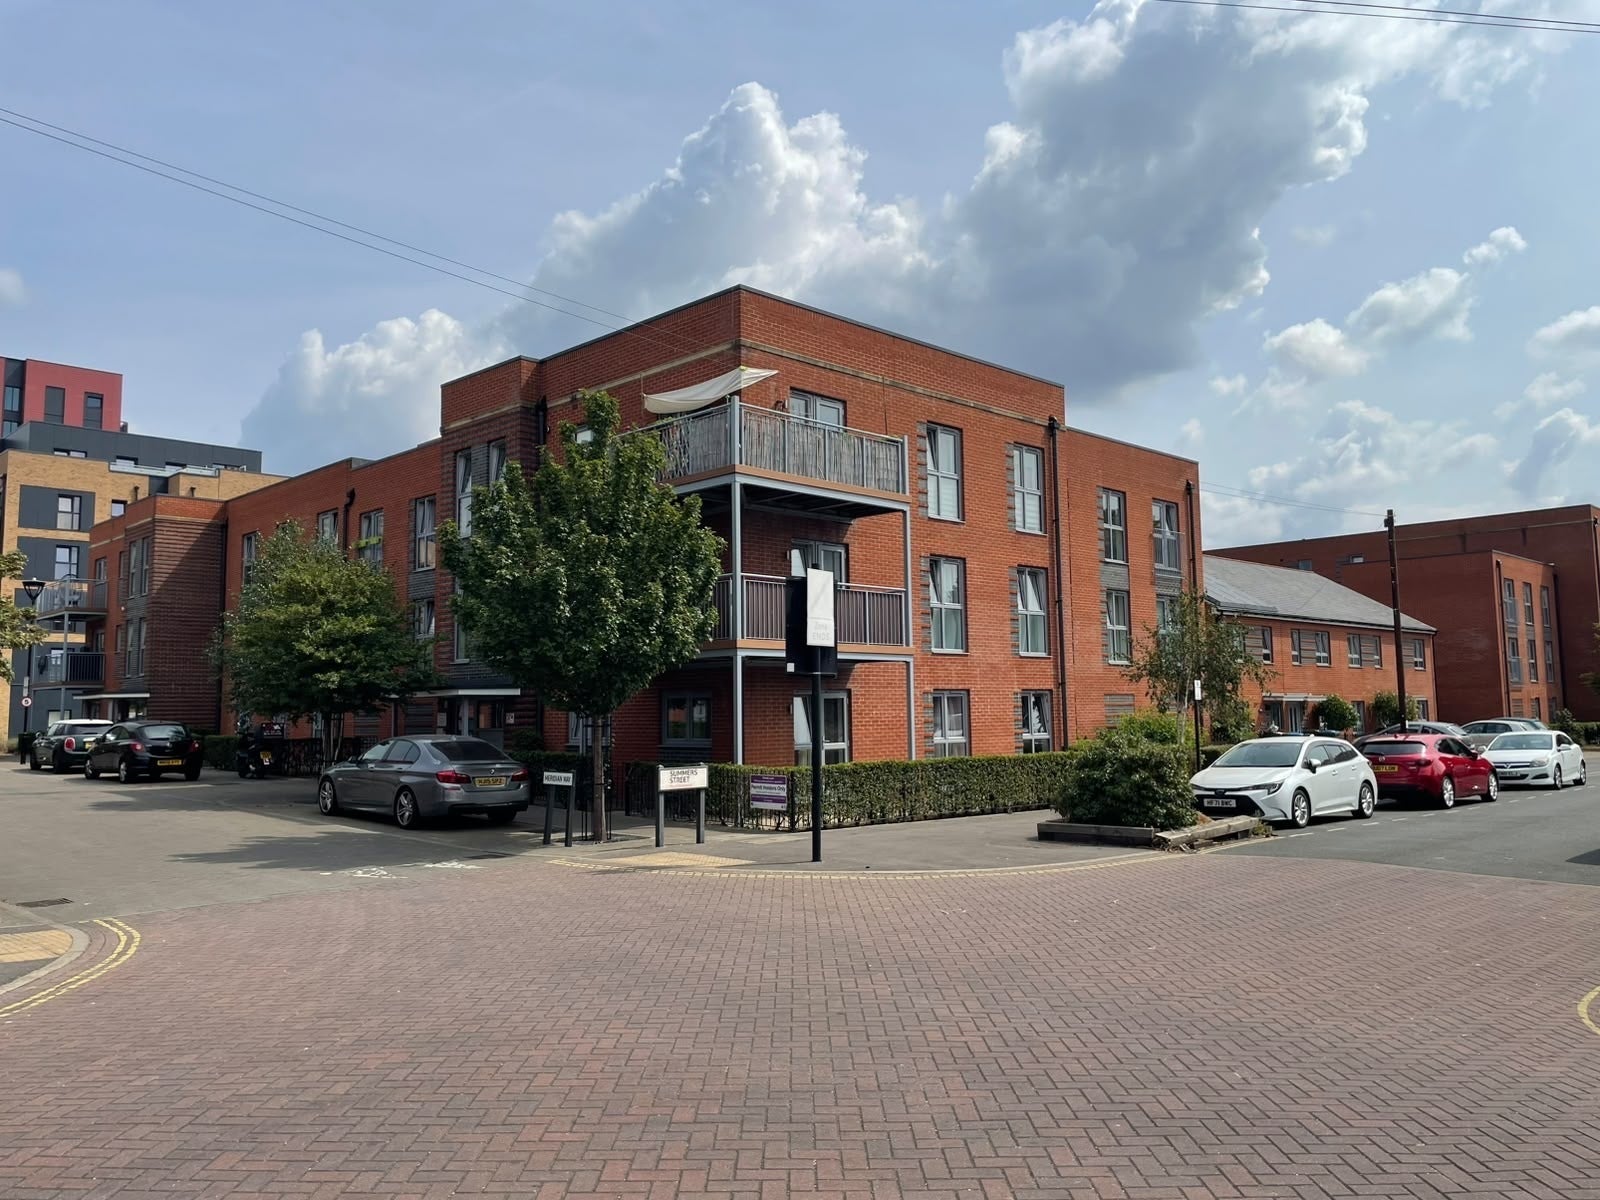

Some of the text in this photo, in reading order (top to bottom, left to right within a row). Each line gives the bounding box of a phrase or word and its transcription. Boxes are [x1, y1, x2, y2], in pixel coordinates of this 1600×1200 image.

[670, 769, 698, 777] SUMMERS
[545, 774, 571, 783] MERIDIAN WAY
[669, 775, 690, 784] STREET
